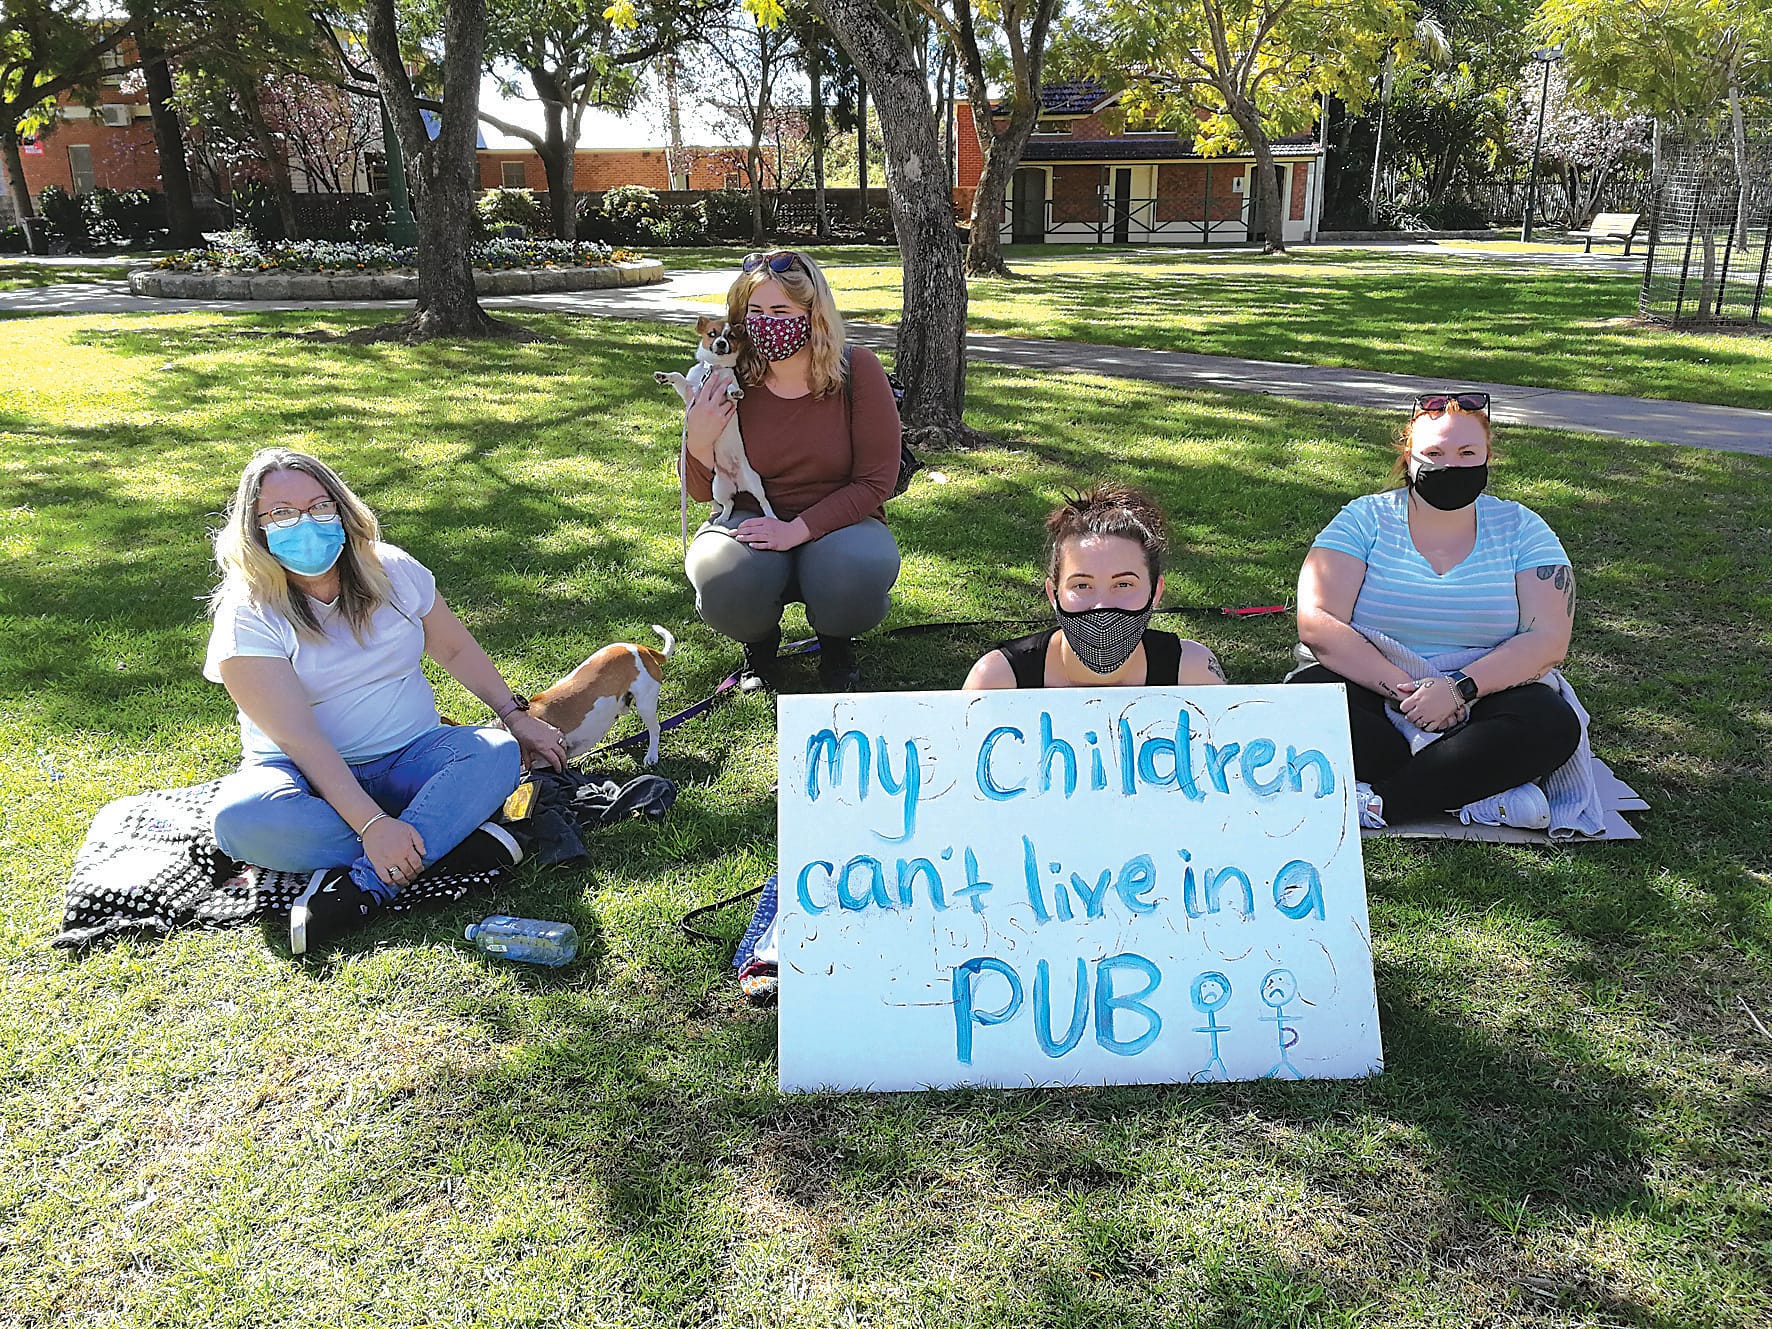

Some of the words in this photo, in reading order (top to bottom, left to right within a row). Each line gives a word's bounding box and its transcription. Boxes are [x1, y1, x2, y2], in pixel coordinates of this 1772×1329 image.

[807, 729, 920, 842] my
[797, 846, 994, 917] can't
[1022, 835, 1158, 924] live
[1178, 848, 1256, 917] in
[1272, 859, 1328, 923] a
[951, 952, 1164, 1067] PUB
